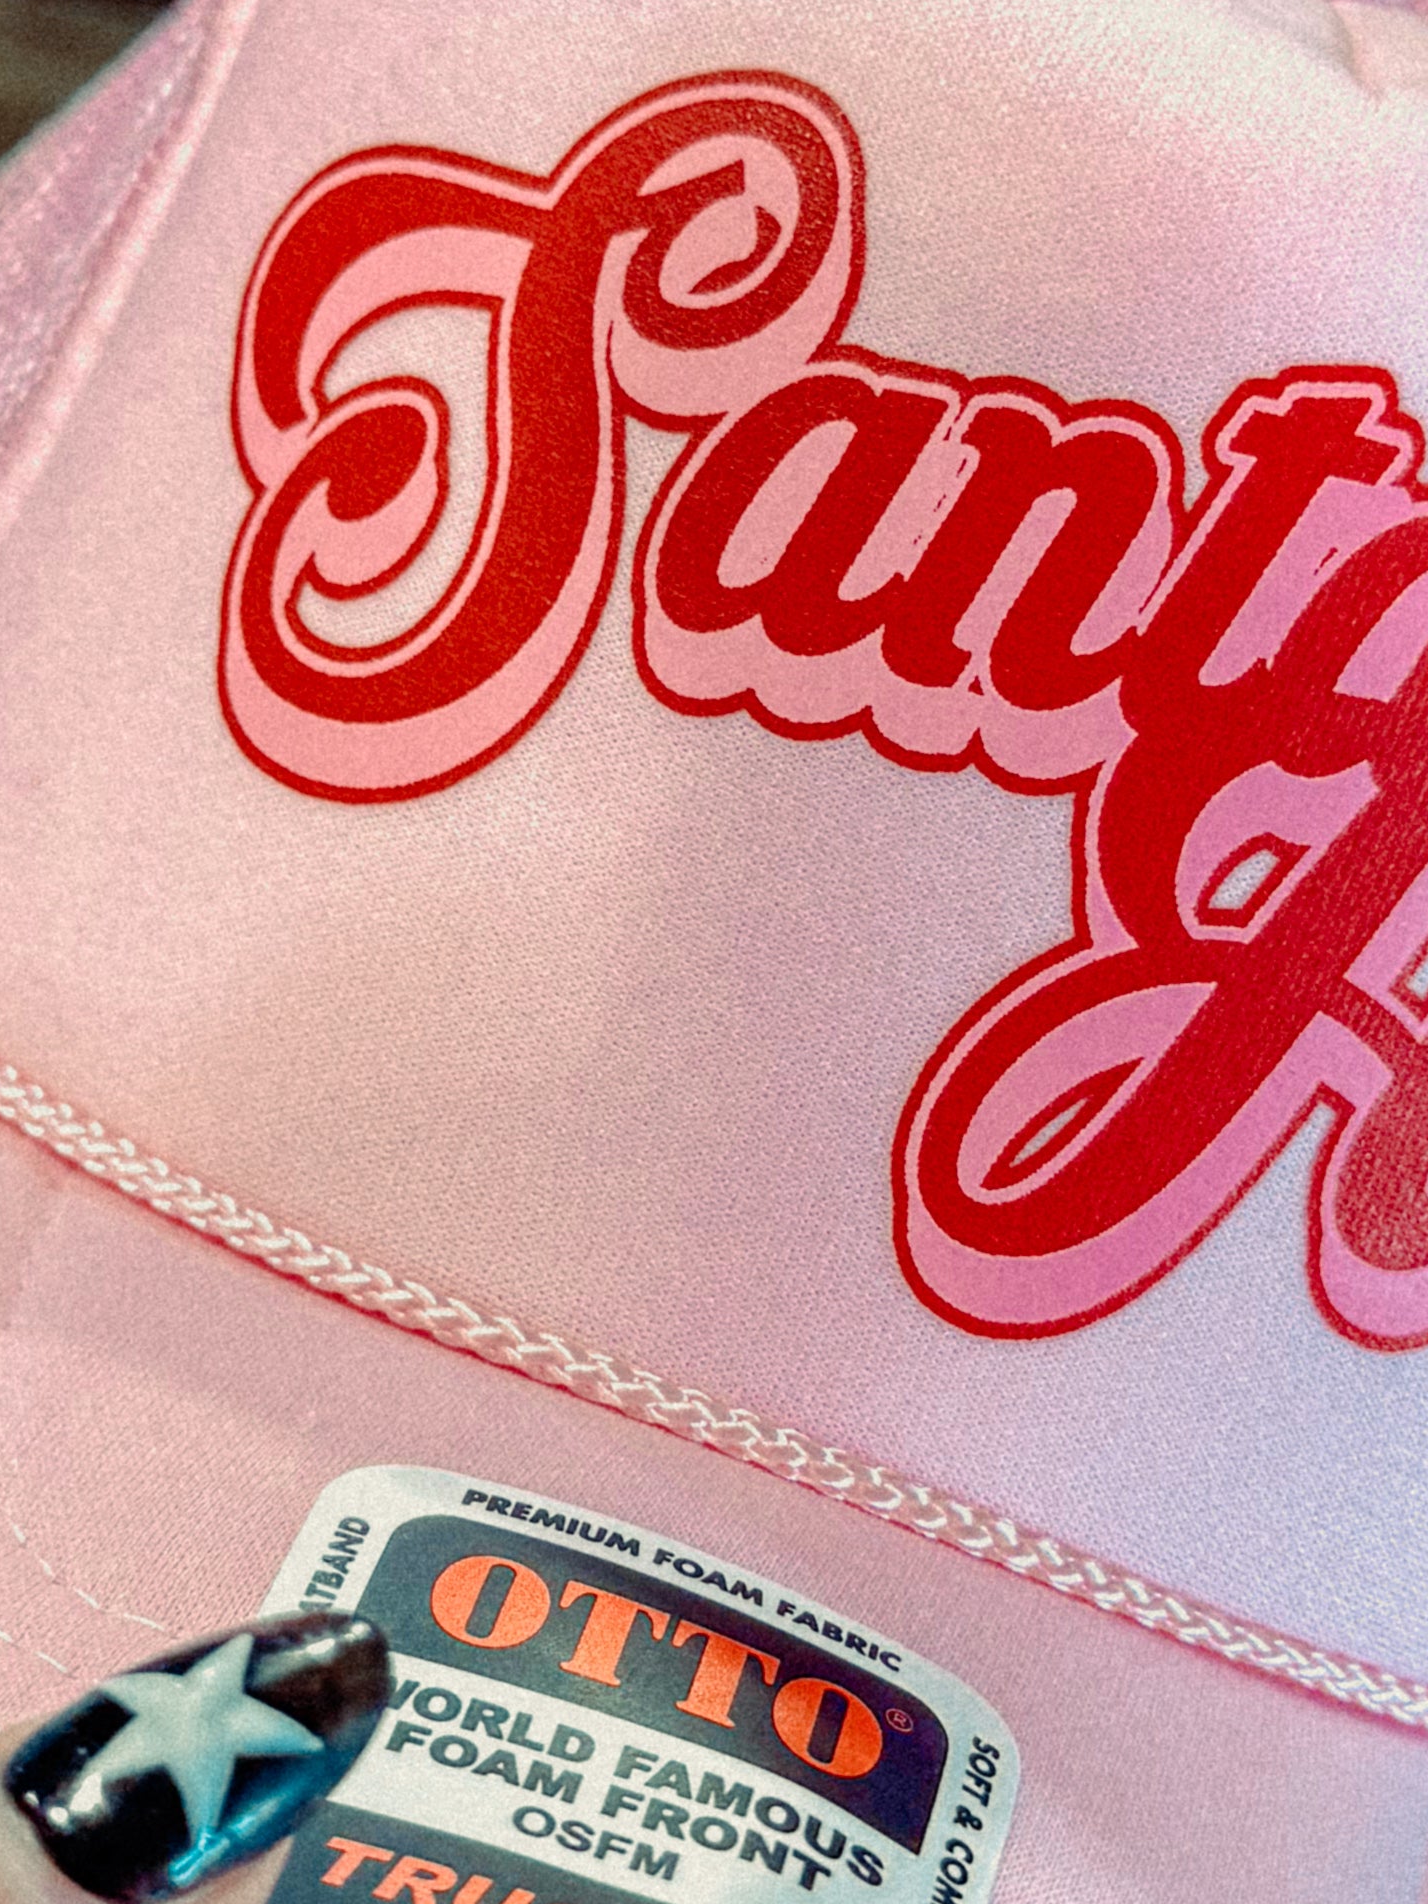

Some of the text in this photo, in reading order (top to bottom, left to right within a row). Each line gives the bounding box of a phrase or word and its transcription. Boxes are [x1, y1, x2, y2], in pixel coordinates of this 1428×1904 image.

[462, 1489, 905, 1674] PREMIUM FOAM FABRIC
[385, 1720, 832, 1892] FOAM FRONT
[615, 1744, 885, 1886] FAMOUS
[954, 1805, 983, 1831] &
[962, 1736, 1002, 1807] SOFT
[512, 1806, 678, 1882] OSFM
